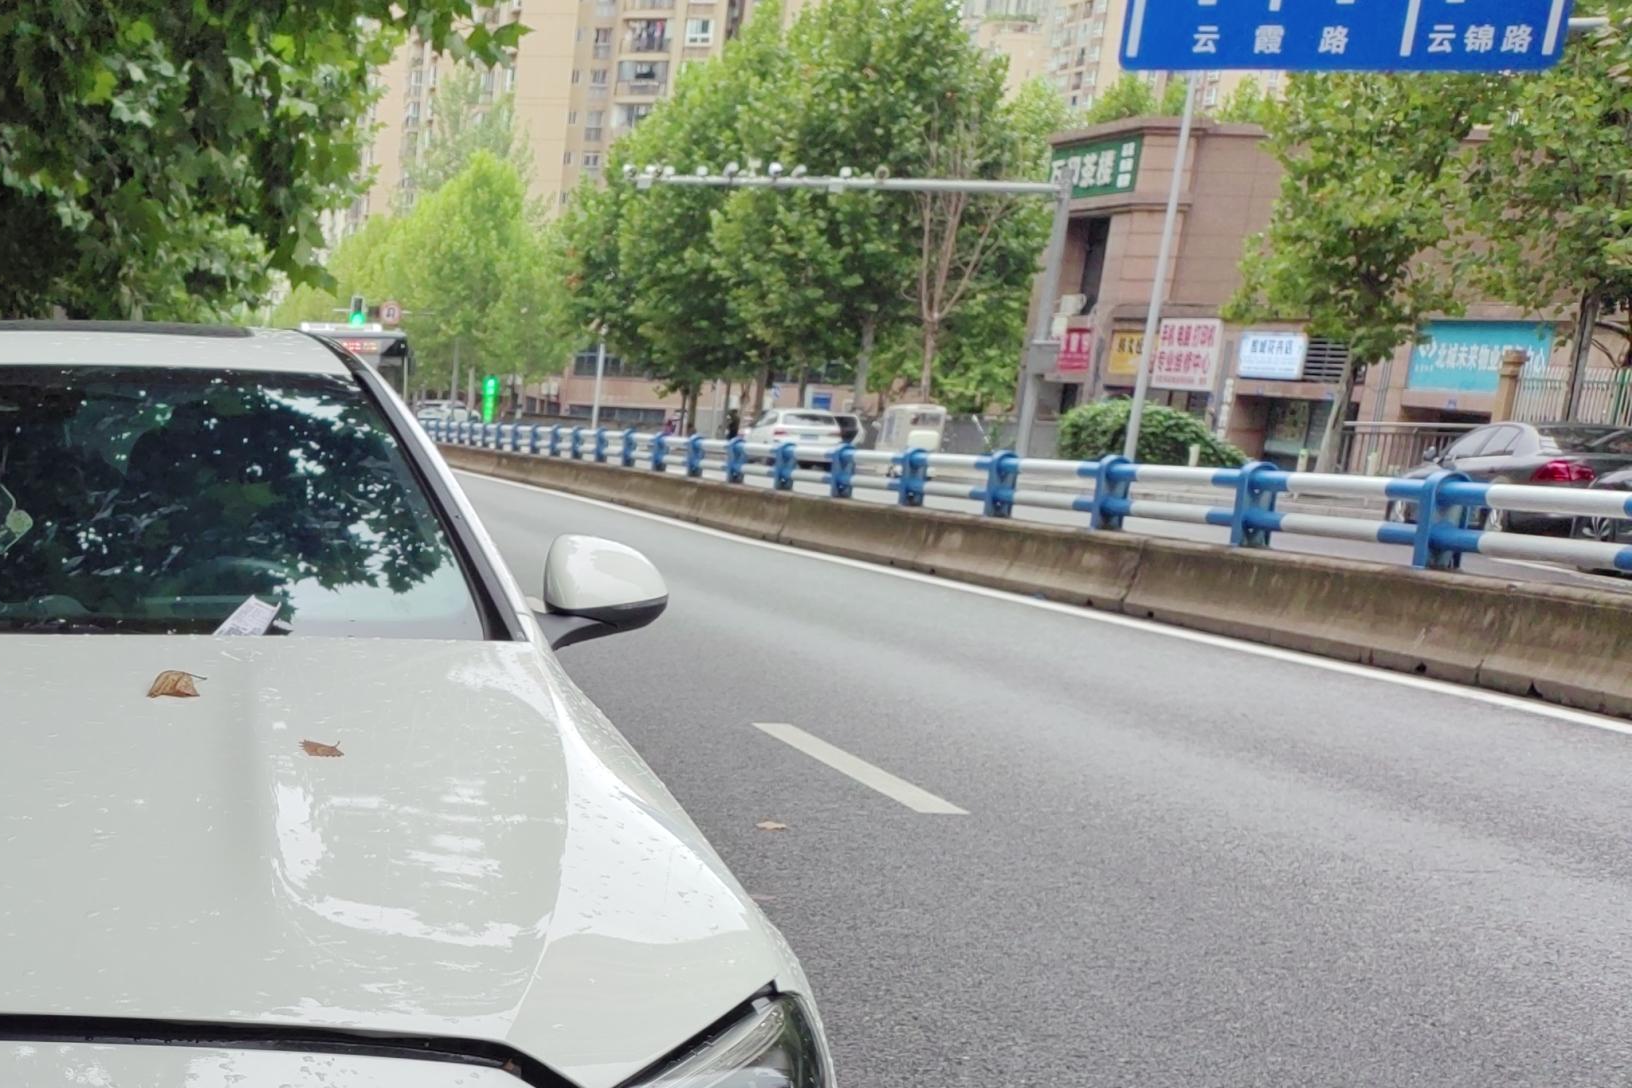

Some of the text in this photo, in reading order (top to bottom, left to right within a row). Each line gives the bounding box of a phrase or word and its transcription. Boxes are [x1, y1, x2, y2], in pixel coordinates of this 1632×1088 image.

[1191, 24, 1349, 54] 云霞路
[1426, 23, 1533, 53] 云锦路
